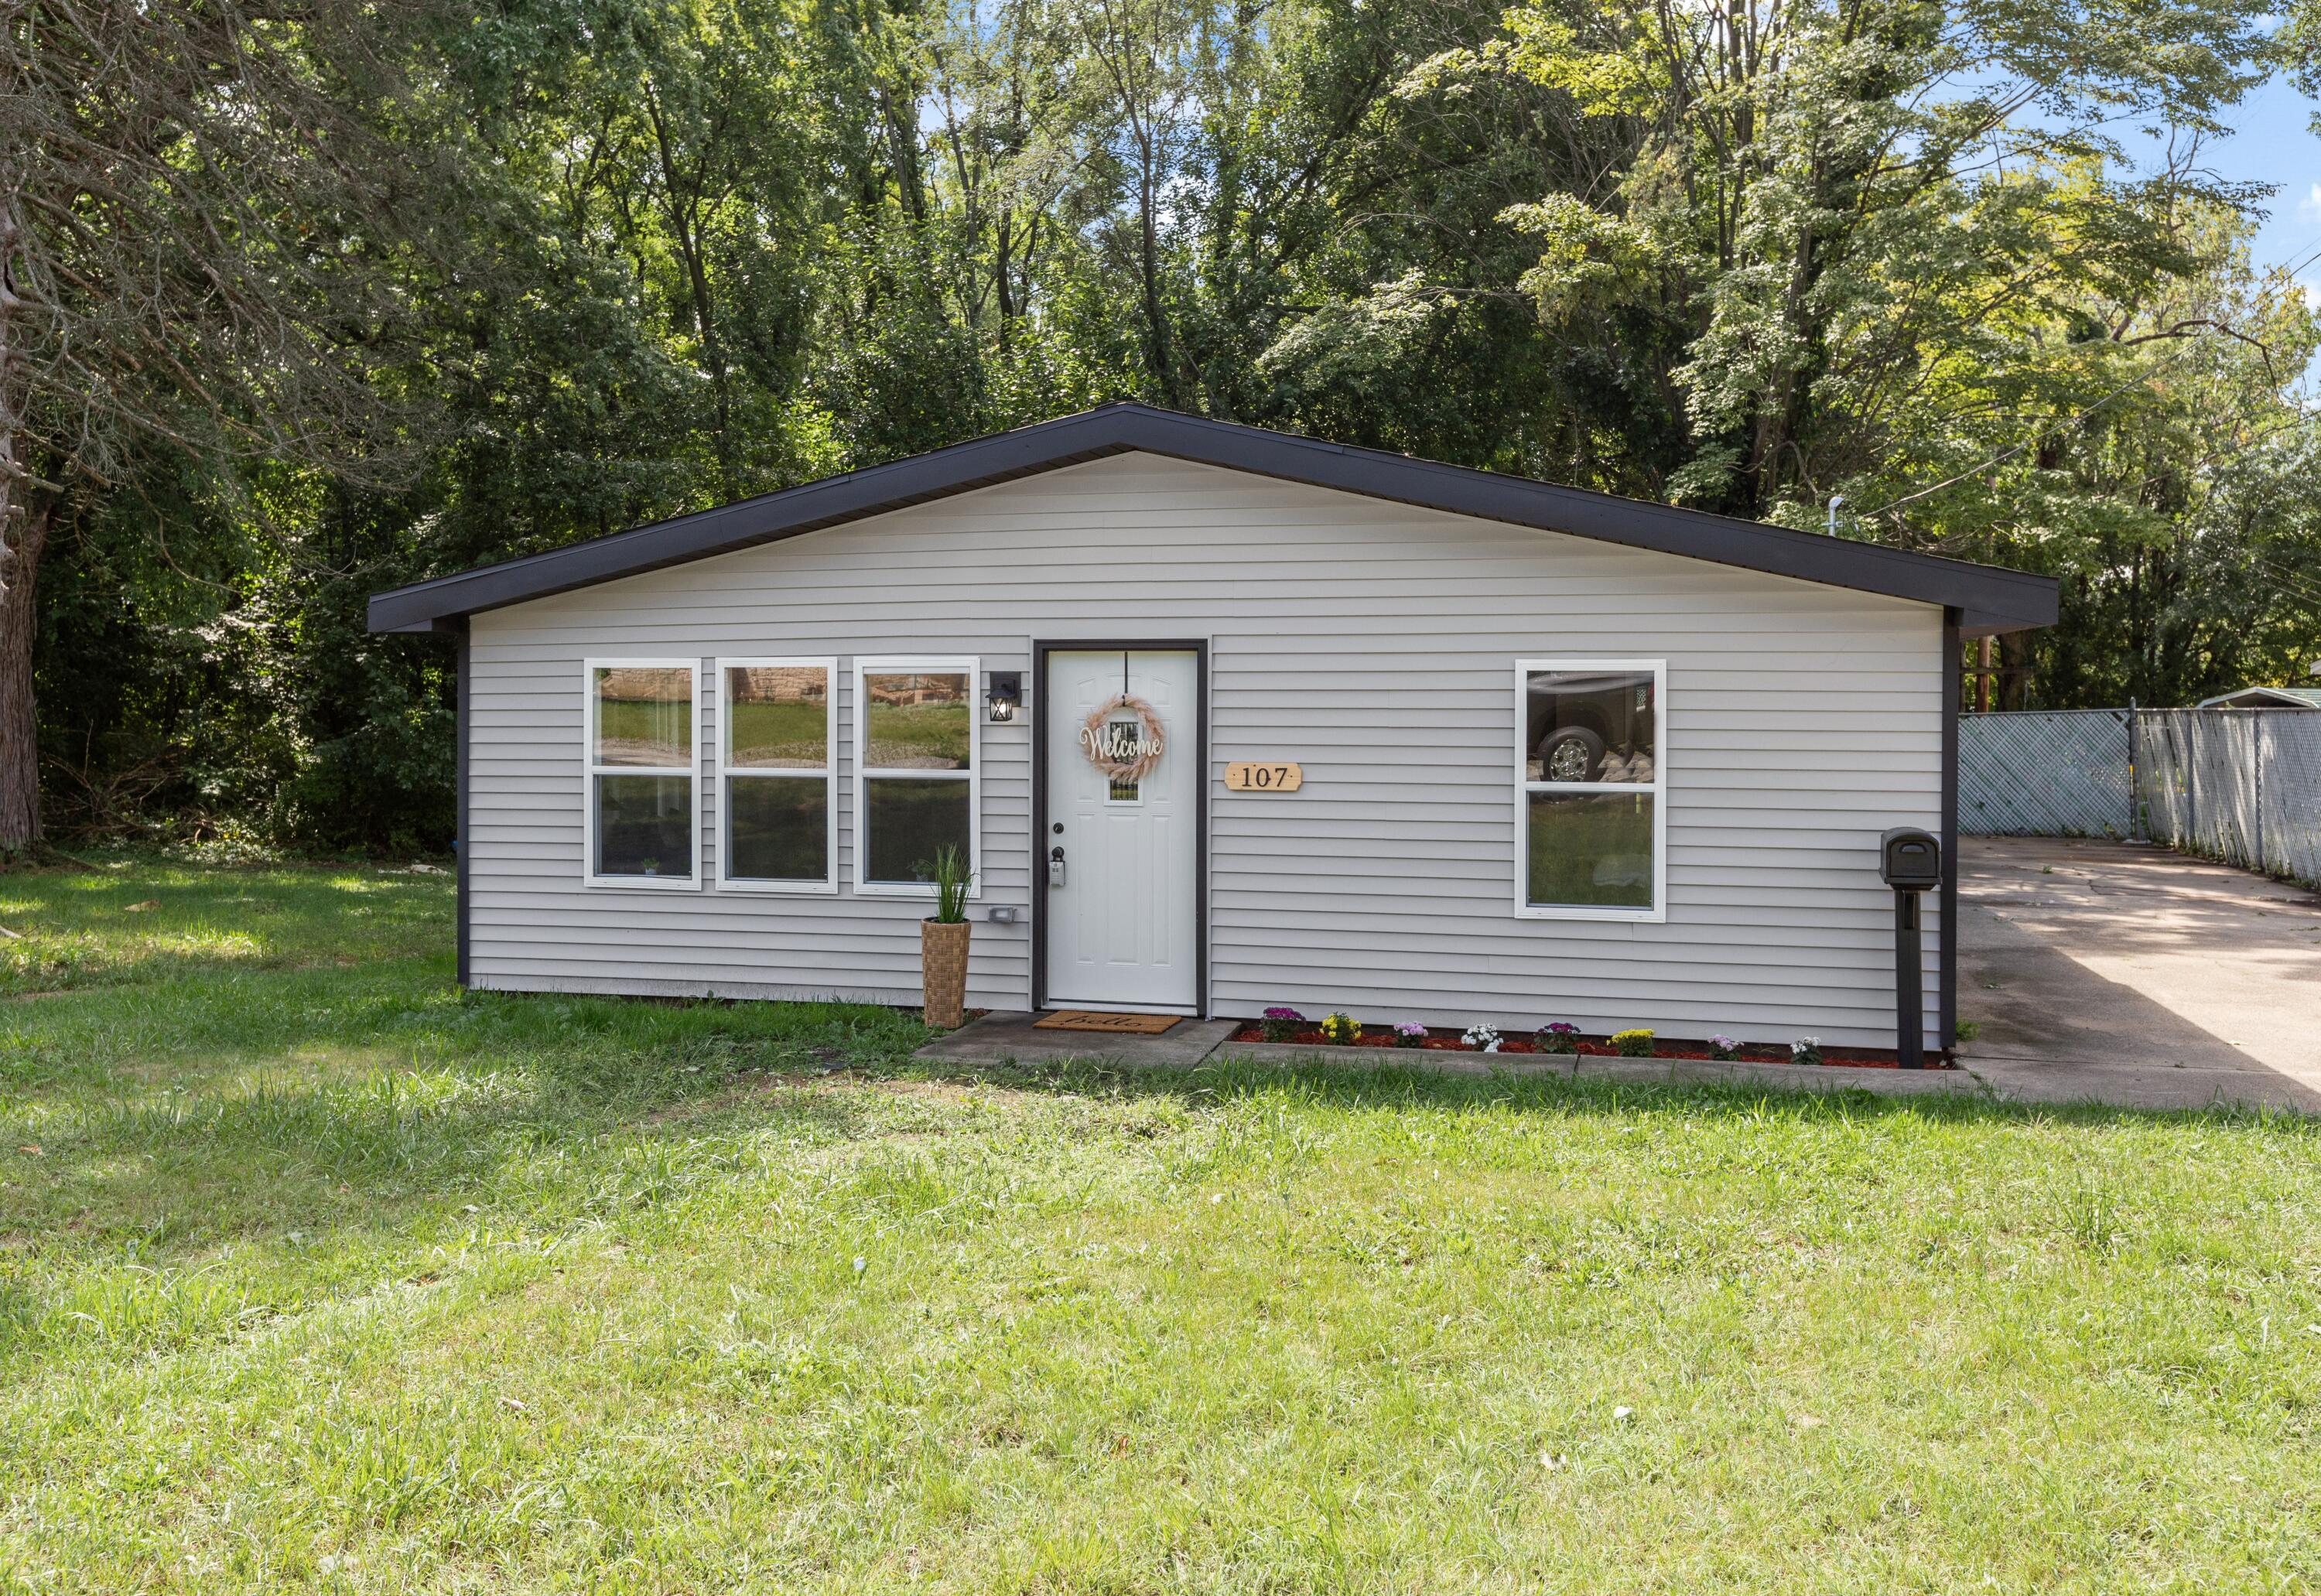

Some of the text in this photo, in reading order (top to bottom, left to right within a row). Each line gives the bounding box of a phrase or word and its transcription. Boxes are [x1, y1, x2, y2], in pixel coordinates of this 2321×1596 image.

[1080, 725, 1163, 760] Welcome
[1242, 767, 1288, 787] 107
[1061, 1016, 1142, 1027] hello
